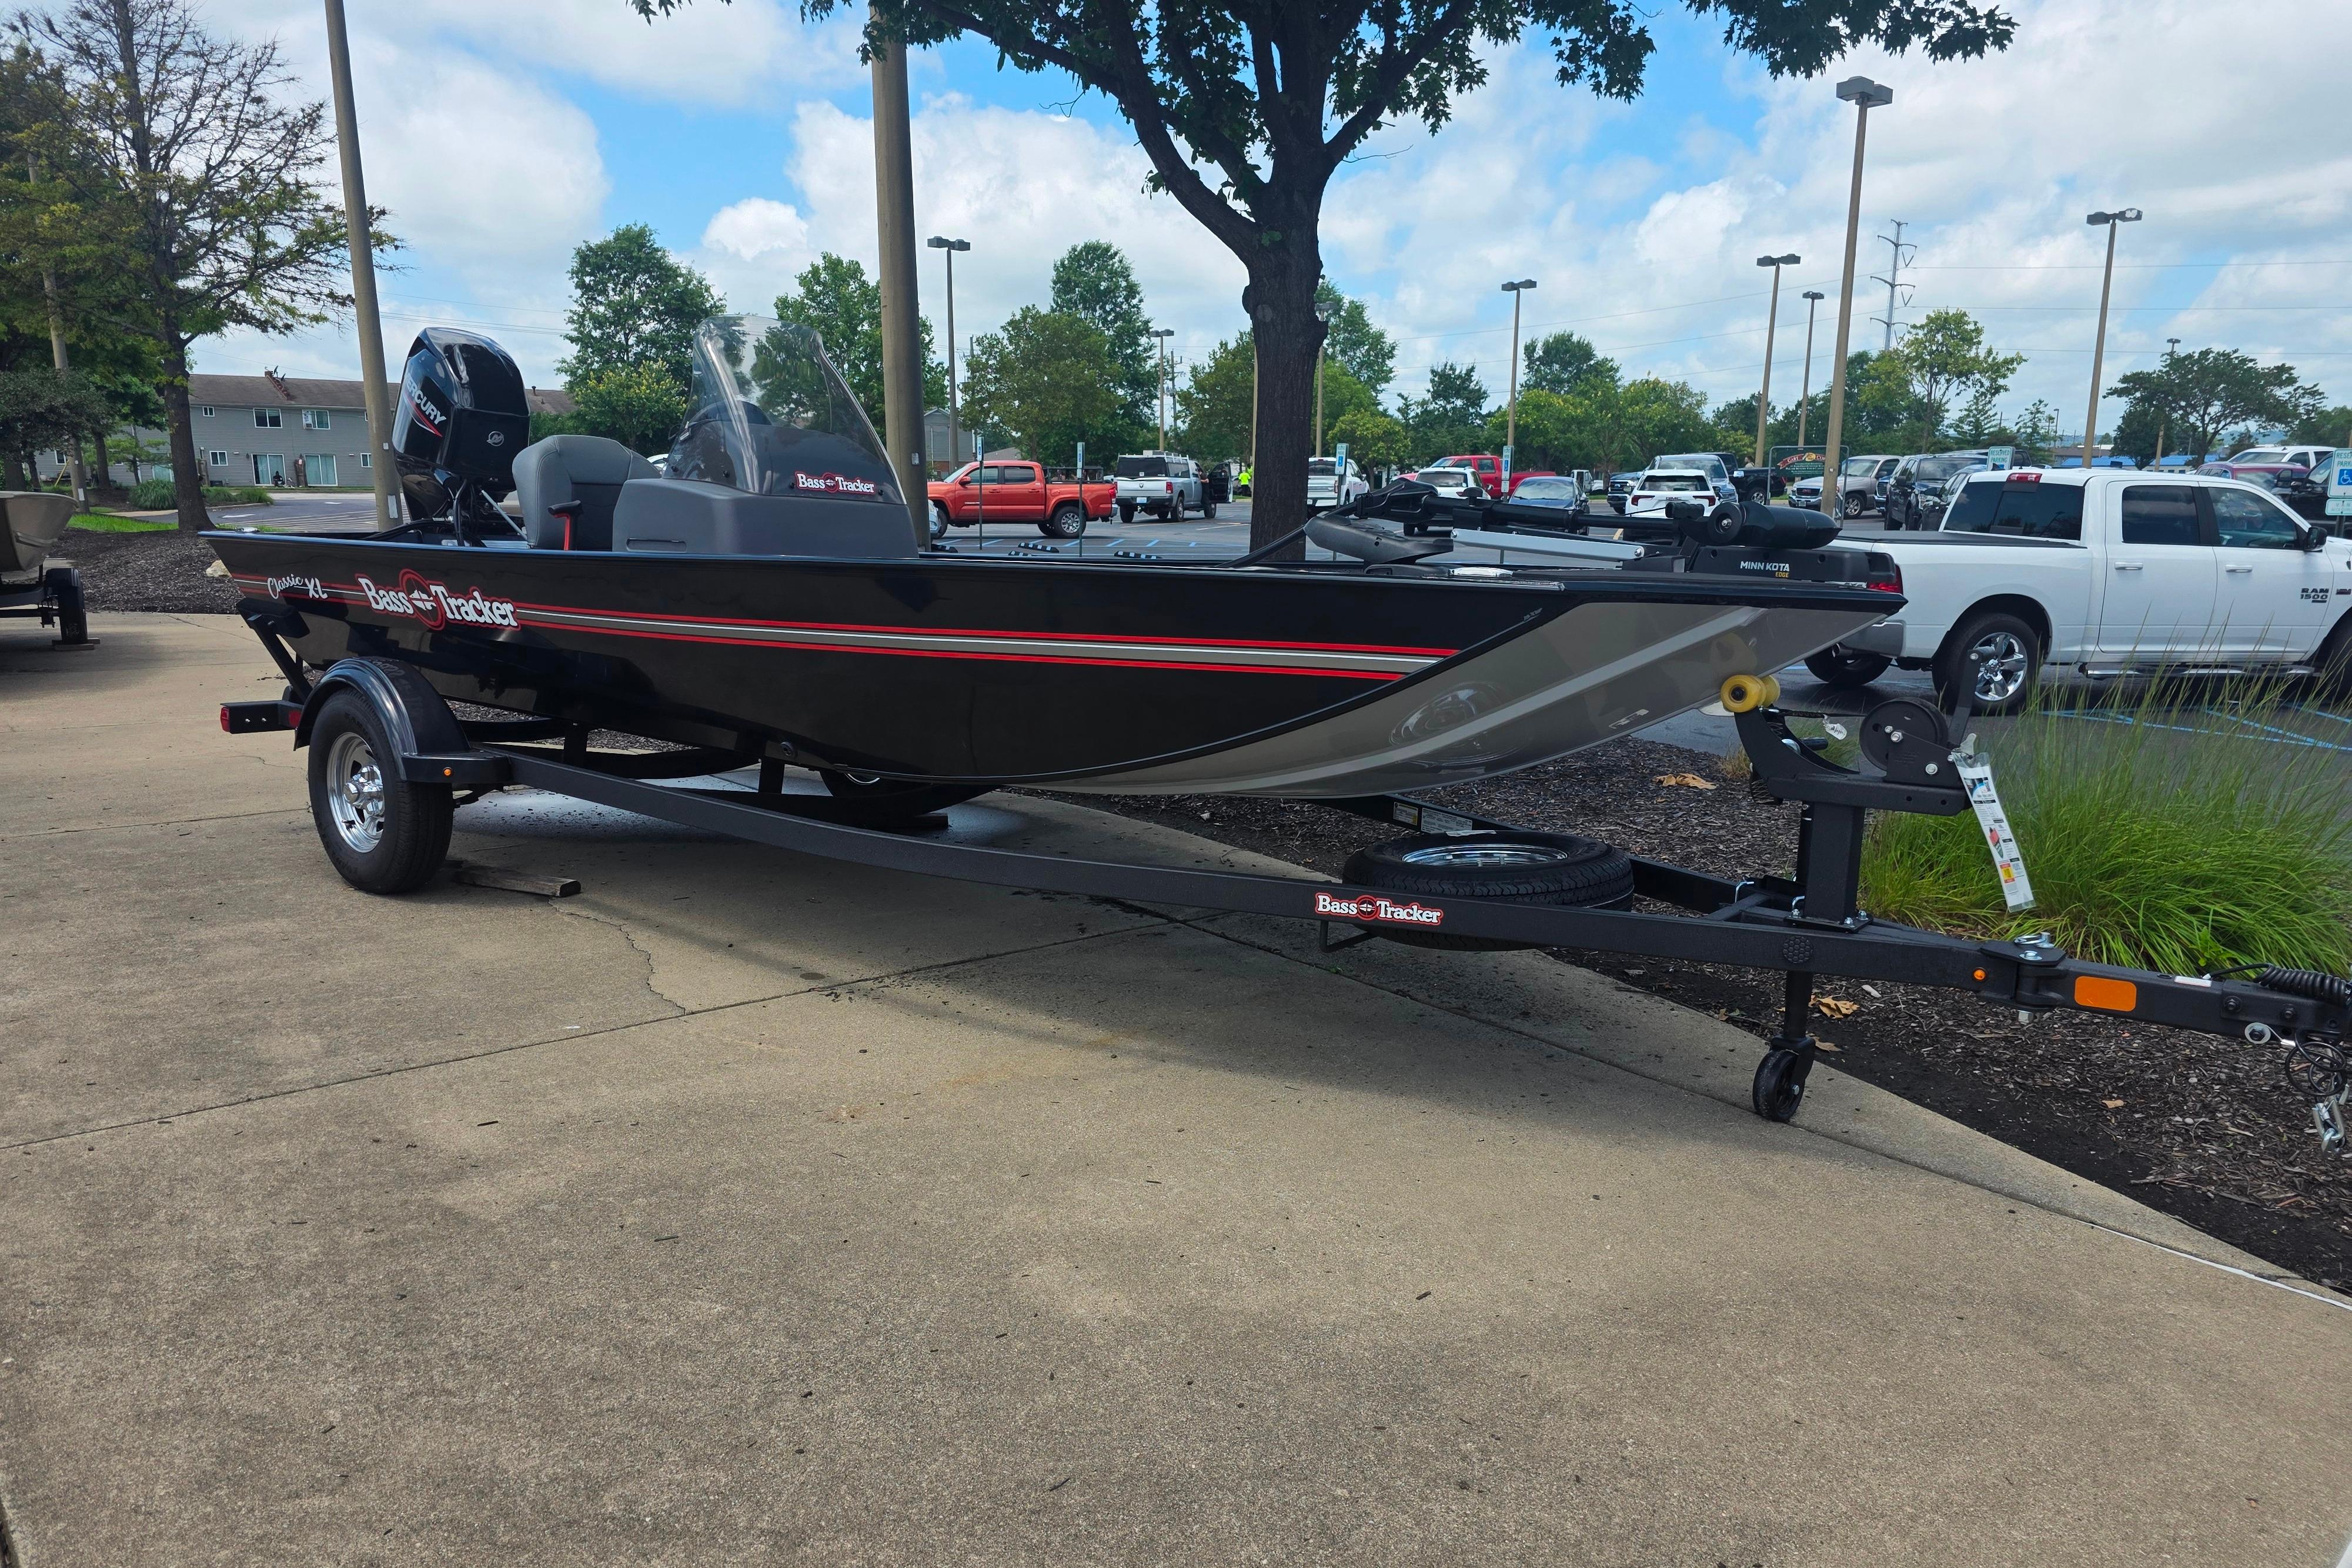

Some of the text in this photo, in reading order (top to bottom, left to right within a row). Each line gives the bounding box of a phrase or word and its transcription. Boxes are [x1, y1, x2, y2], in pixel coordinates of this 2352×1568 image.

[406, 372, 447, 425] ERCURY
[797, 473, 874, 493] Bass Tracker
[1740, 561, 1790, 571] MINN KOTA
[268, 574, 328, 599] Classic XL
[358, 578, 517, 626] Bass Tracker
[1318, 895, 1441, 923] Bass Tracker
